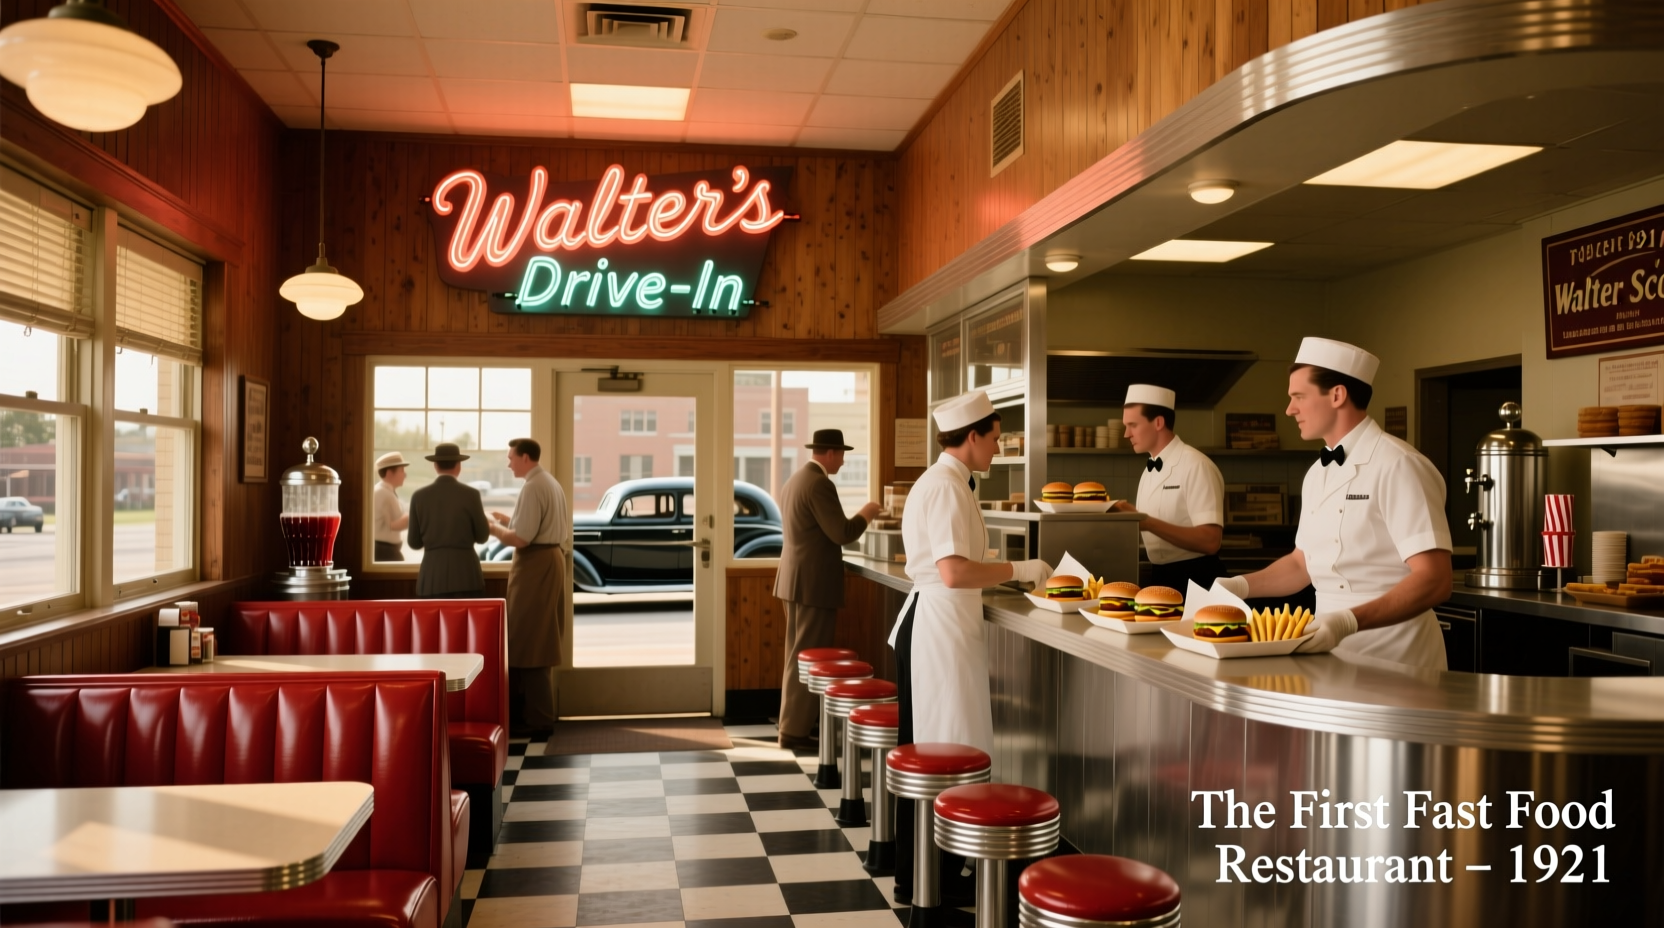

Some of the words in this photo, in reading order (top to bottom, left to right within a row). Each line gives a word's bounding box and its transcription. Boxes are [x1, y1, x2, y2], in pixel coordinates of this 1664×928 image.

[432, 163, 785, 273] Walter's
[515, 256, 744, 310] Drive-In
[1554, 276, 1624, 315] Walter
